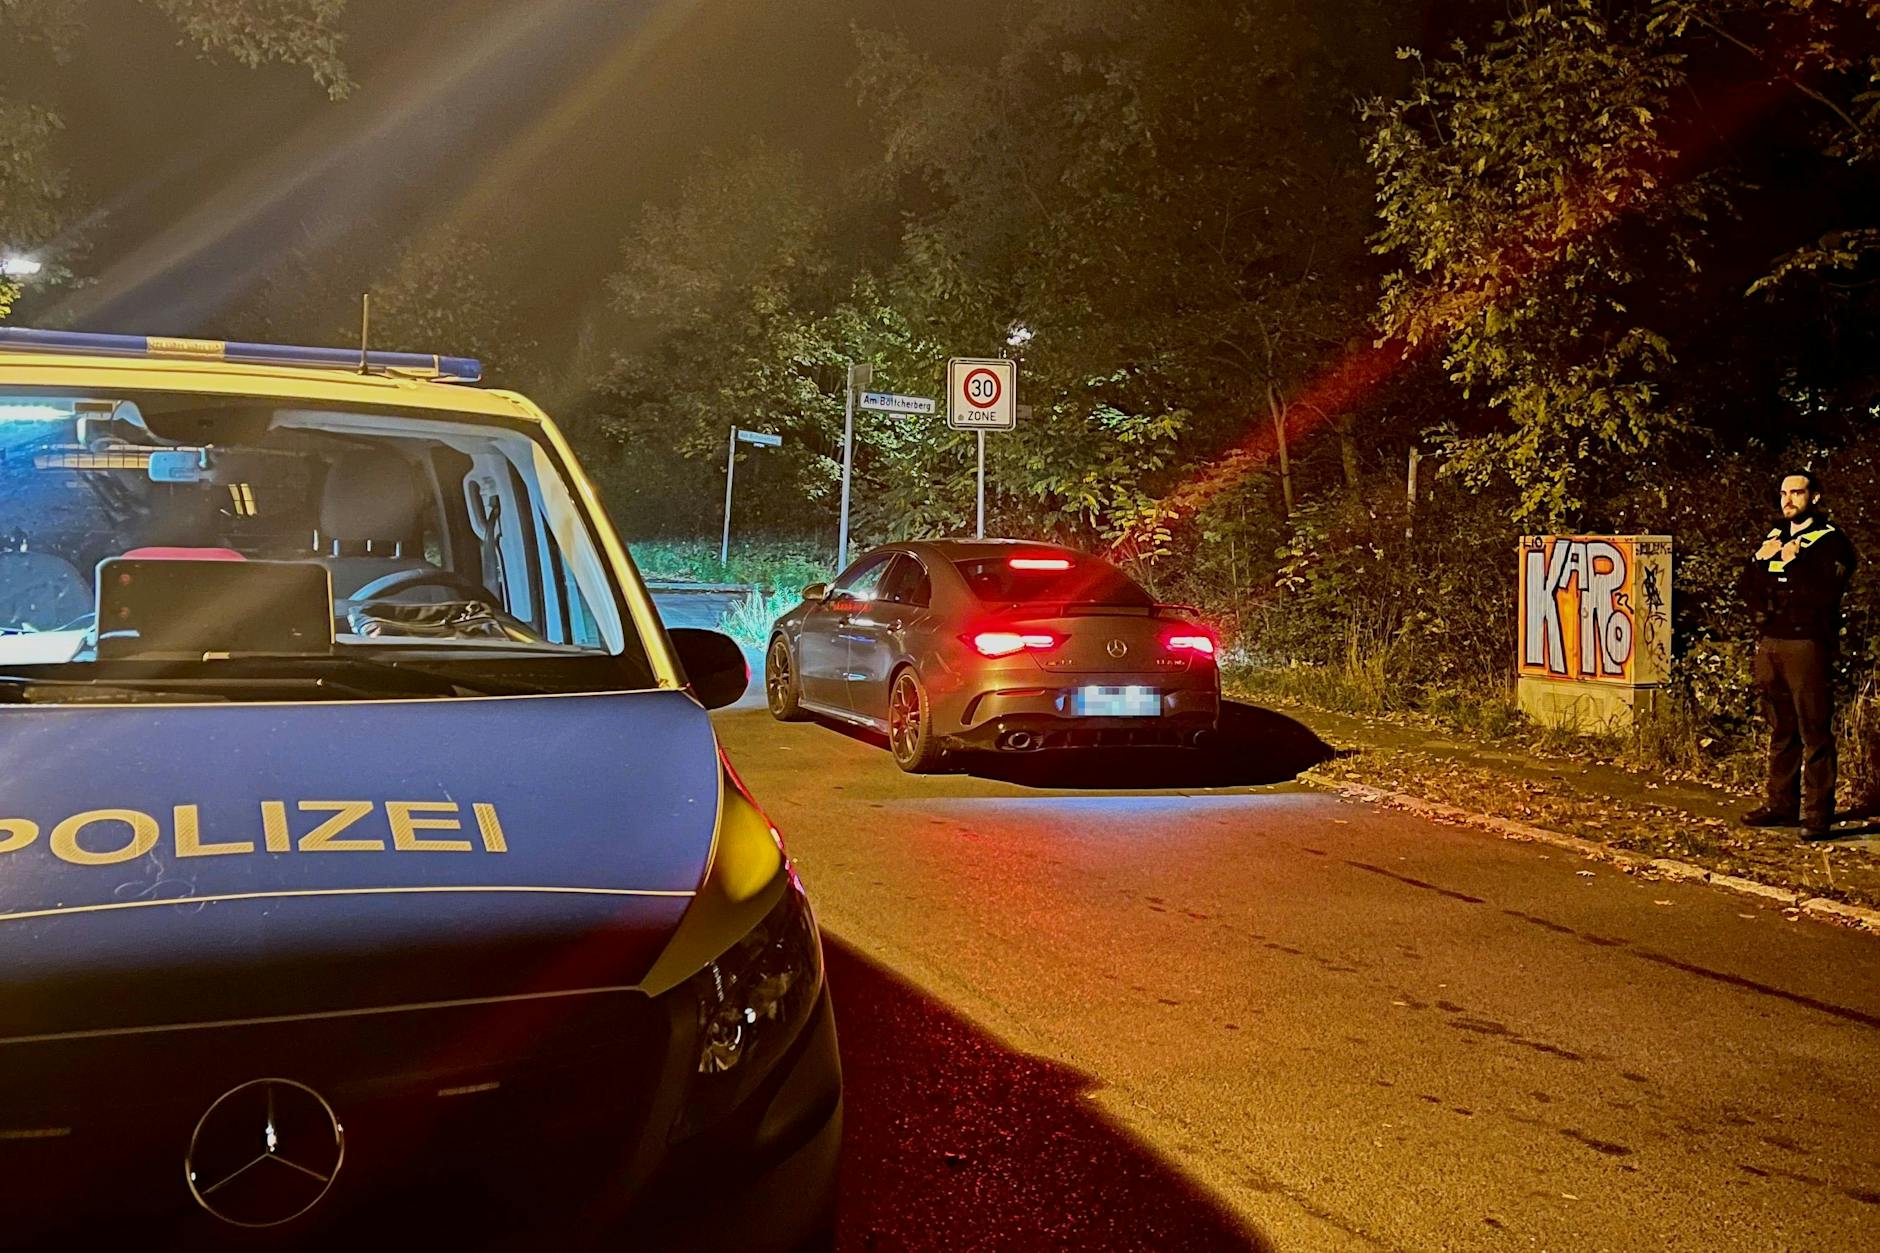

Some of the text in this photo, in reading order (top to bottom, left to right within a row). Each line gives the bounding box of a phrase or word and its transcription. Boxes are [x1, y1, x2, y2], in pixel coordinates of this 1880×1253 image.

[971, 379, 994, 398] 30
[863, 394, 932, 412] Am Böttcherberg
[967, 410, 997, 421] ZONE
